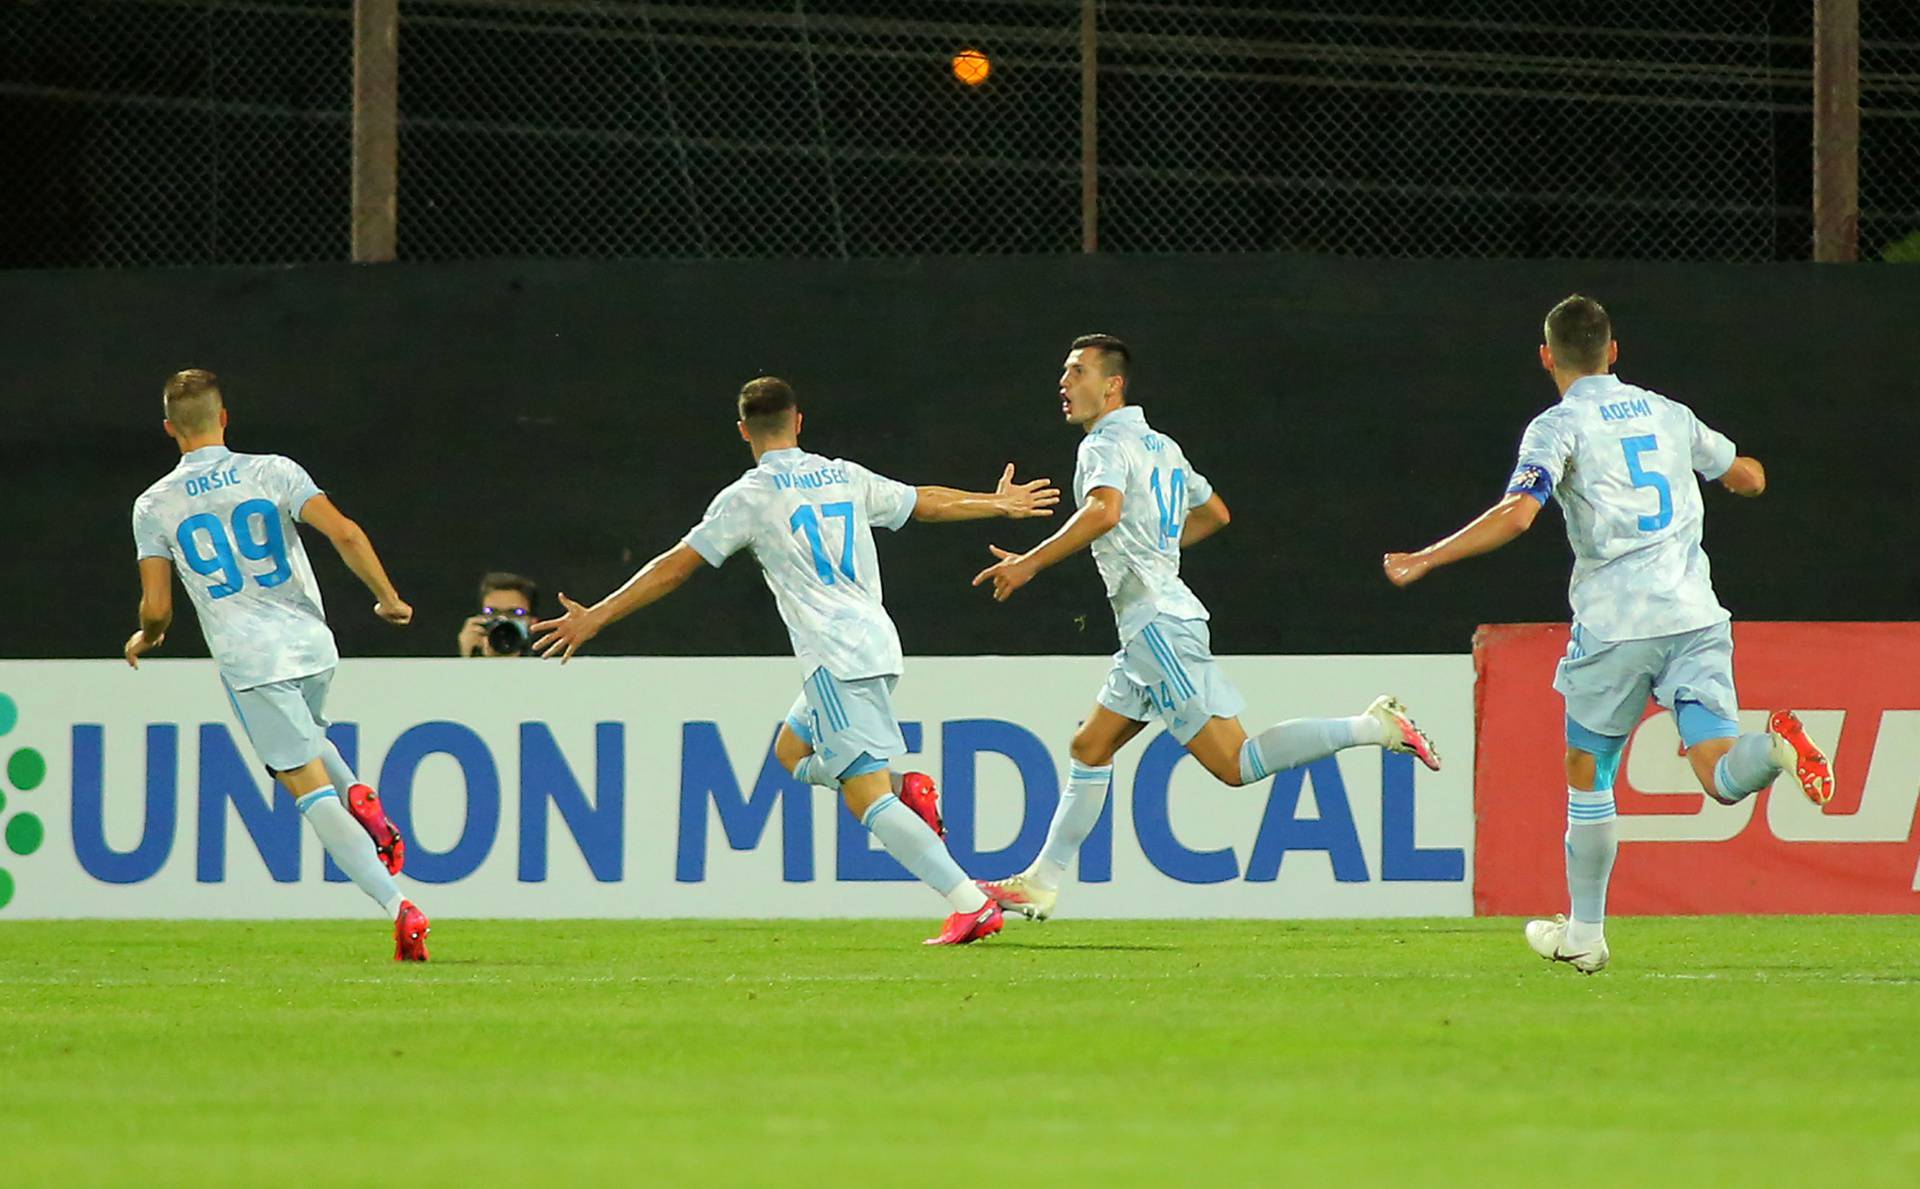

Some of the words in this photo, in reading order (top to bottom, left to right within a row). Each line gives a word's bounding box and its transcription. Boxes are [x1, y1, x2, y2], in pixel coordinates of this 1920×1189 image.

[1599, 399, 1653, 421] ADEMI
[1620, 434, 1673, 532] 5
[176, 498, 292, 600] 99
[790, 501, 856, 586] 17
